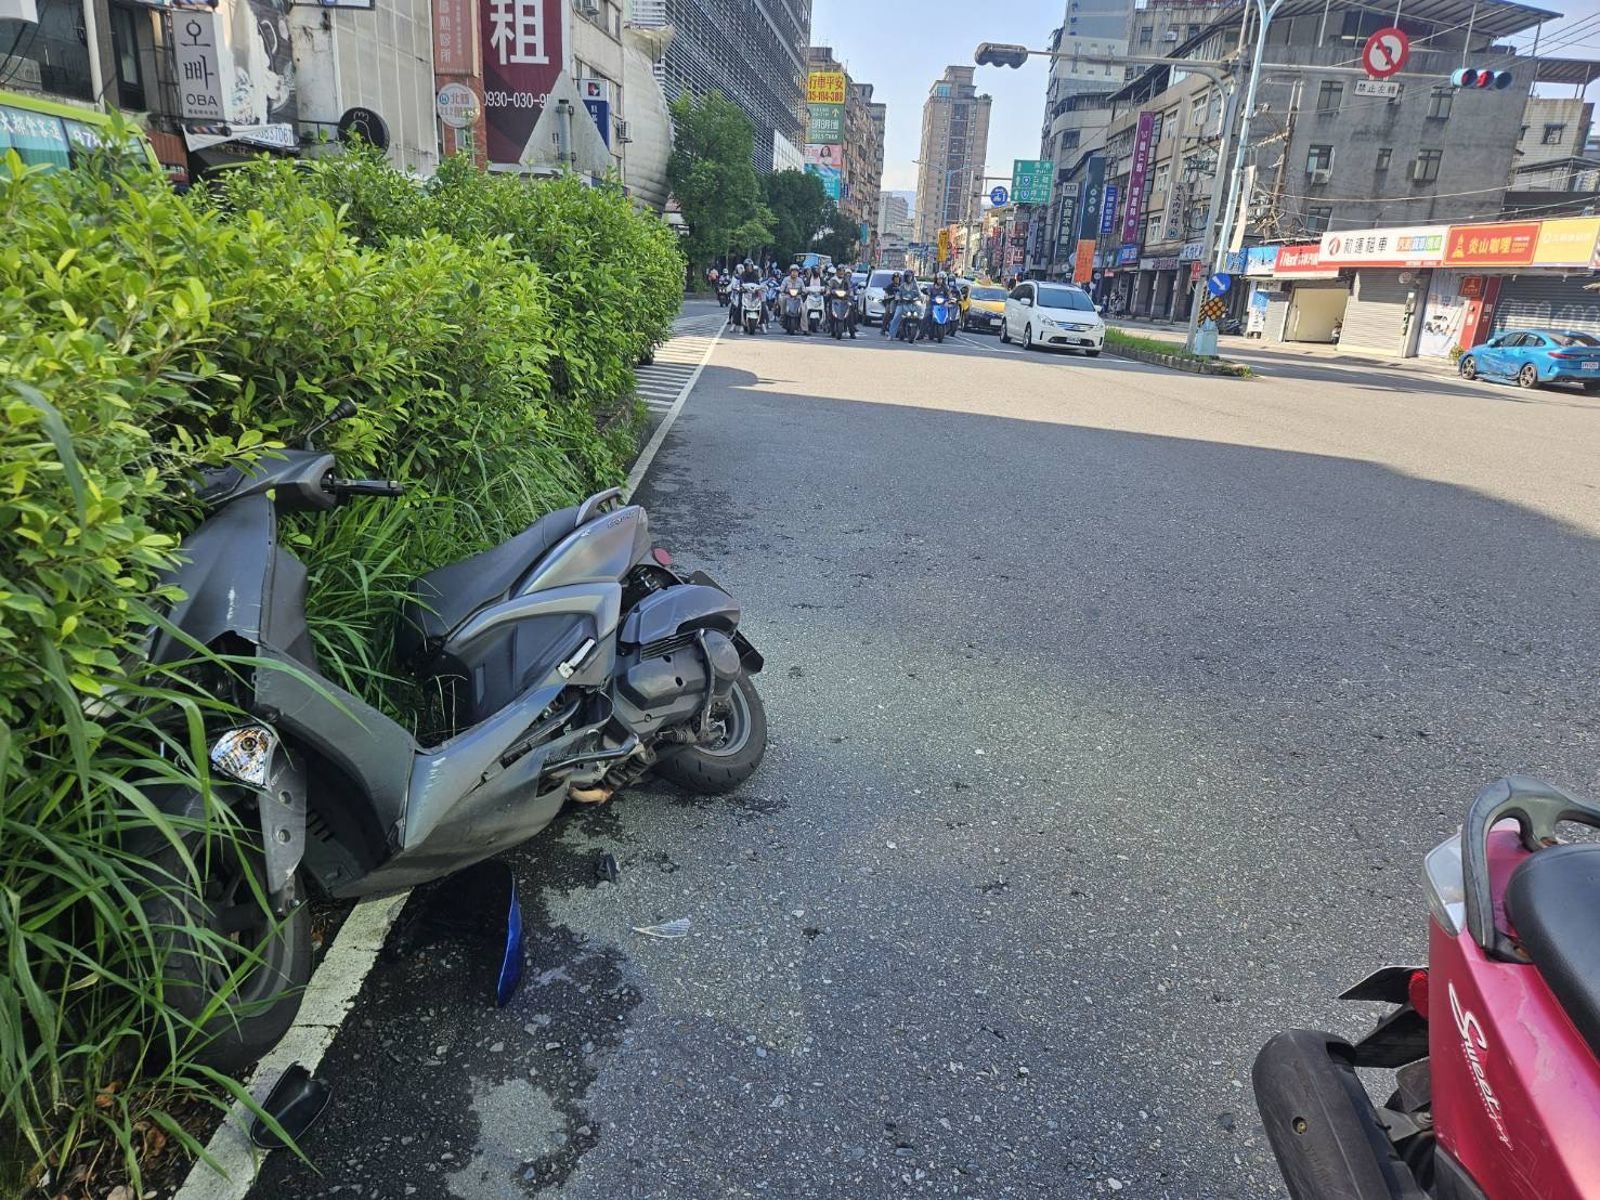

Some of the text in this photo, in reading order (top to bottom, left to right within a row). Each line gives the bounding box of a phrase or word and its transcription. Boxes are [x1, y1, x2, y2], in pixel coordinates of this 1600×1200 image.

[181, 19, 214, 90] 오빠
[490, 0, 549, 65] 租
[186, 93, 218, 107] OBA
[1358, 83, 1396, 95] 禁止左轉
[1448, 981, 1500, 1117] Sweet
